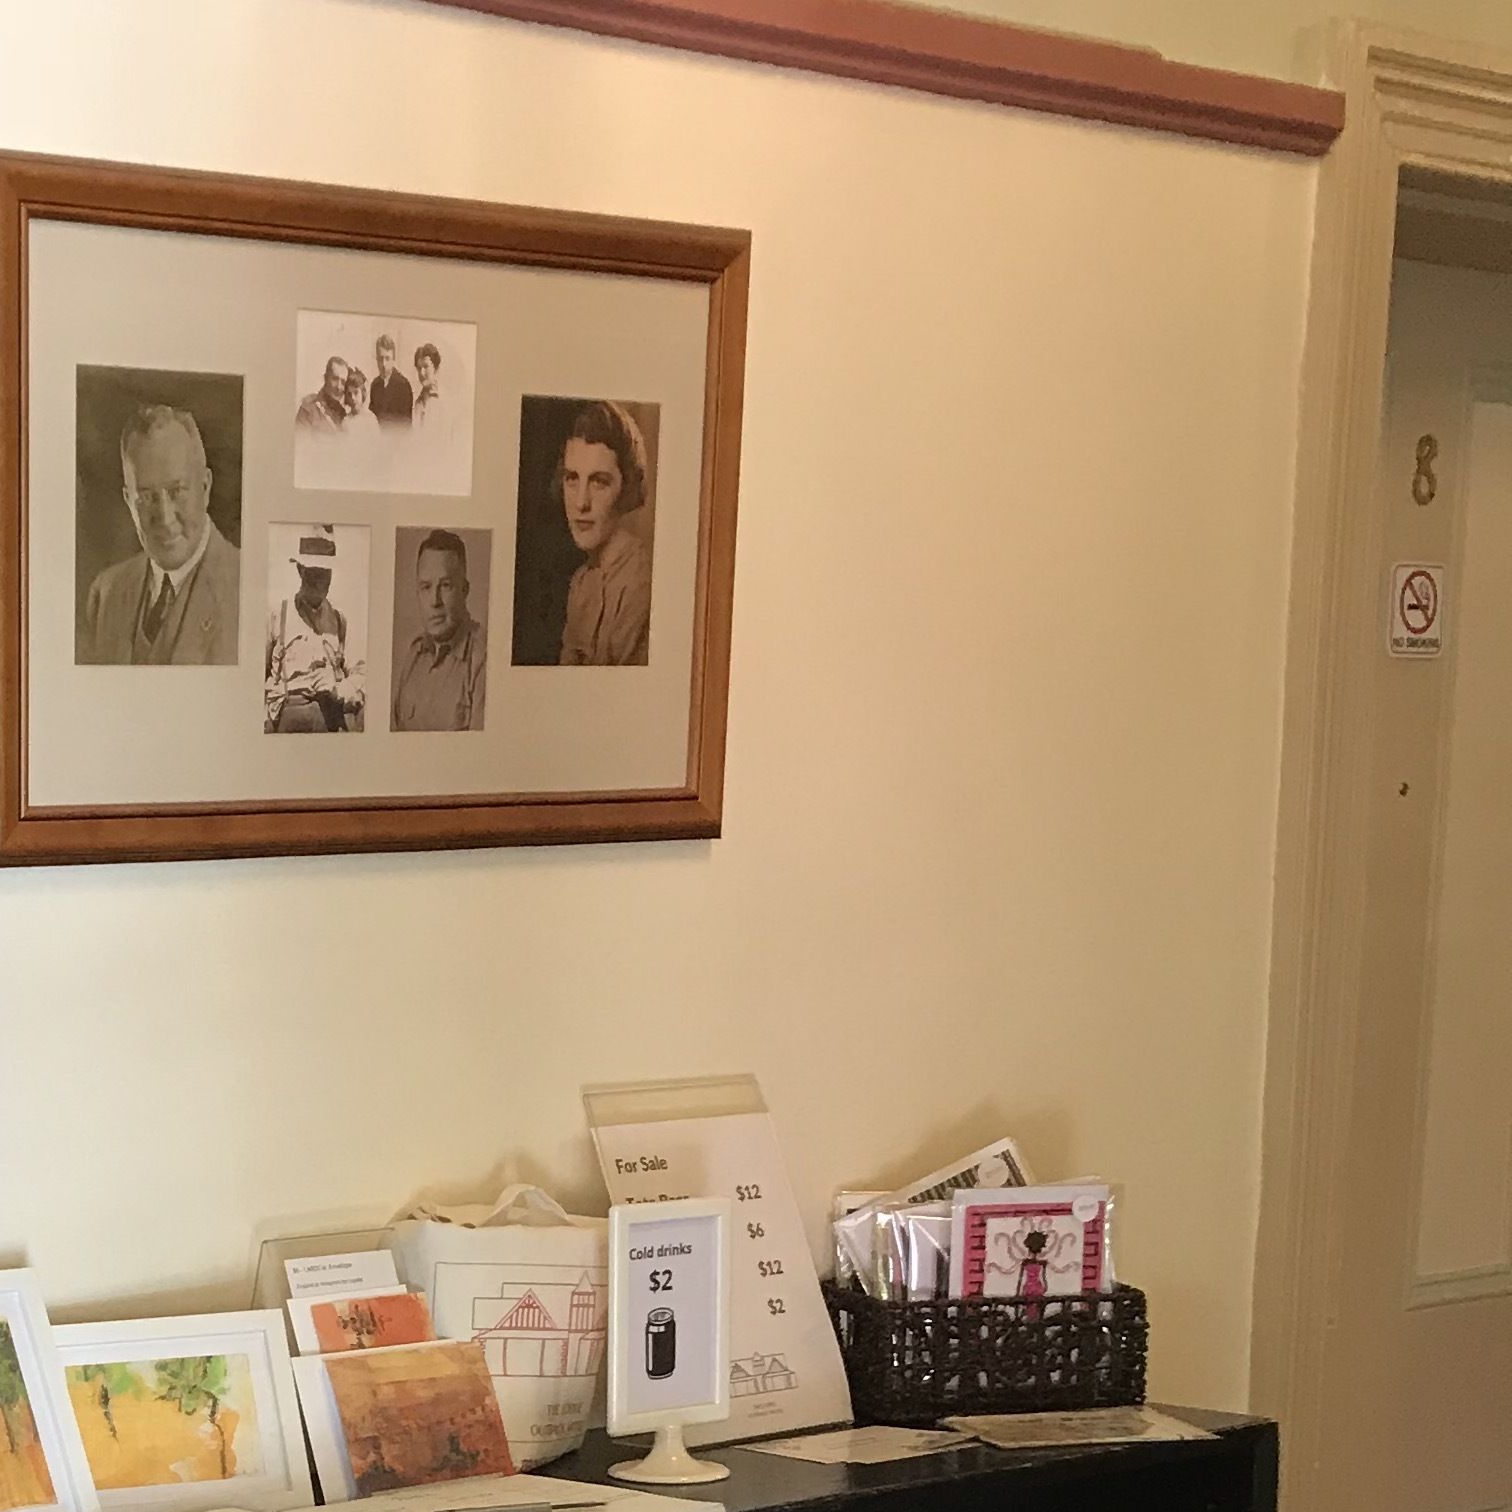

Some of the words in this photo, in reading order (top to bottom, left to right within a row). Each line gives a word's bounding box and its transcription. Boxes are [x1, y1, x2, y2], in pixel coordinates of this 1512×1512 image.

[1411, 434, 1438, 506] 8
[616, 1158, 638, 1174] For
[640, 1155, 668, 1173] Sale
[736, 1184, 762, 1201] $12
[747, 1222, 765, 1239] $6
[629, 1246, 655, 1260] Cold
[657, 1242, 692, 1258] drinks
[758, 1259, 784, 1277] $12
[649, 1269, 673, 1293] $2
[767, 1298, 786, 1316] $2
